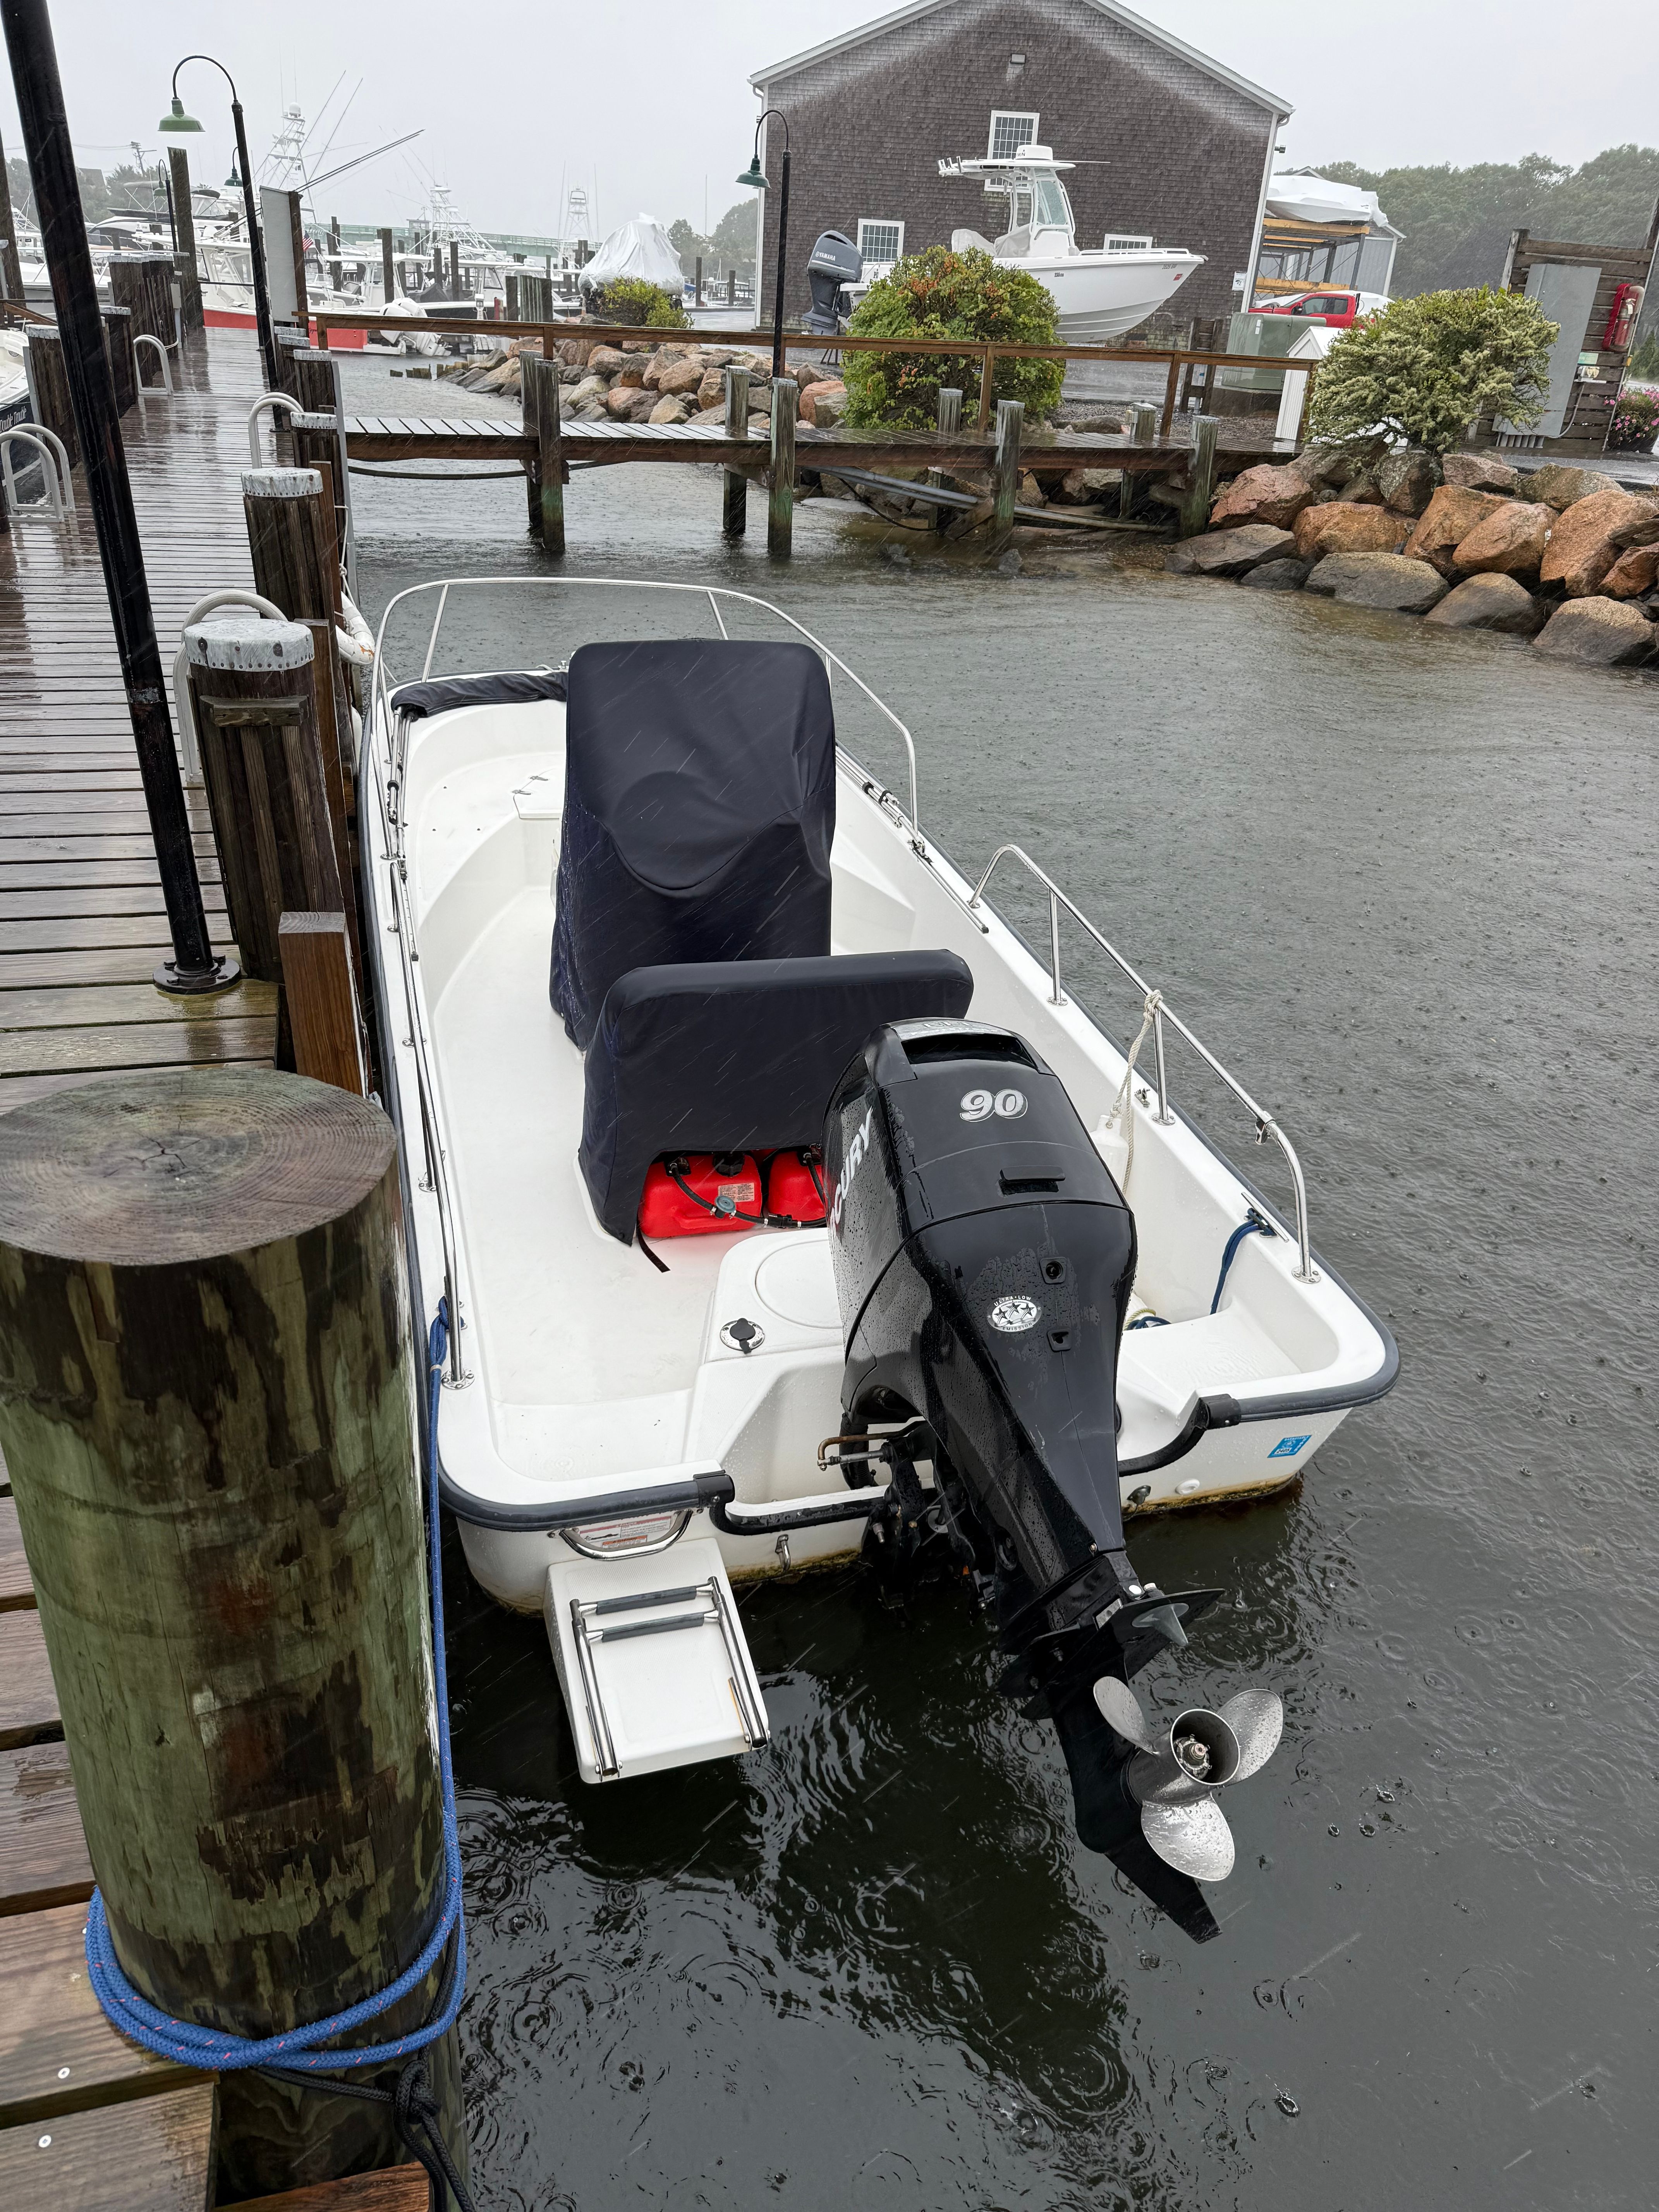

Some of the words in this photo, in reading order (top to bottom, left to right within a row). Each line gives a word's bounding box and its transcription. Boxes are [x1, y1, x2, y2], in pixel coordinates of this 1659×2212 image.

[819, 252, 836, 261] YAMAHA
[14, 406, 27, 425] Trouble
[960, 1089, 1028, 1122] 90
[829, 1105, 873, 1251] RCURY
[1002, 1322, 1032, 1331] EMISSION
